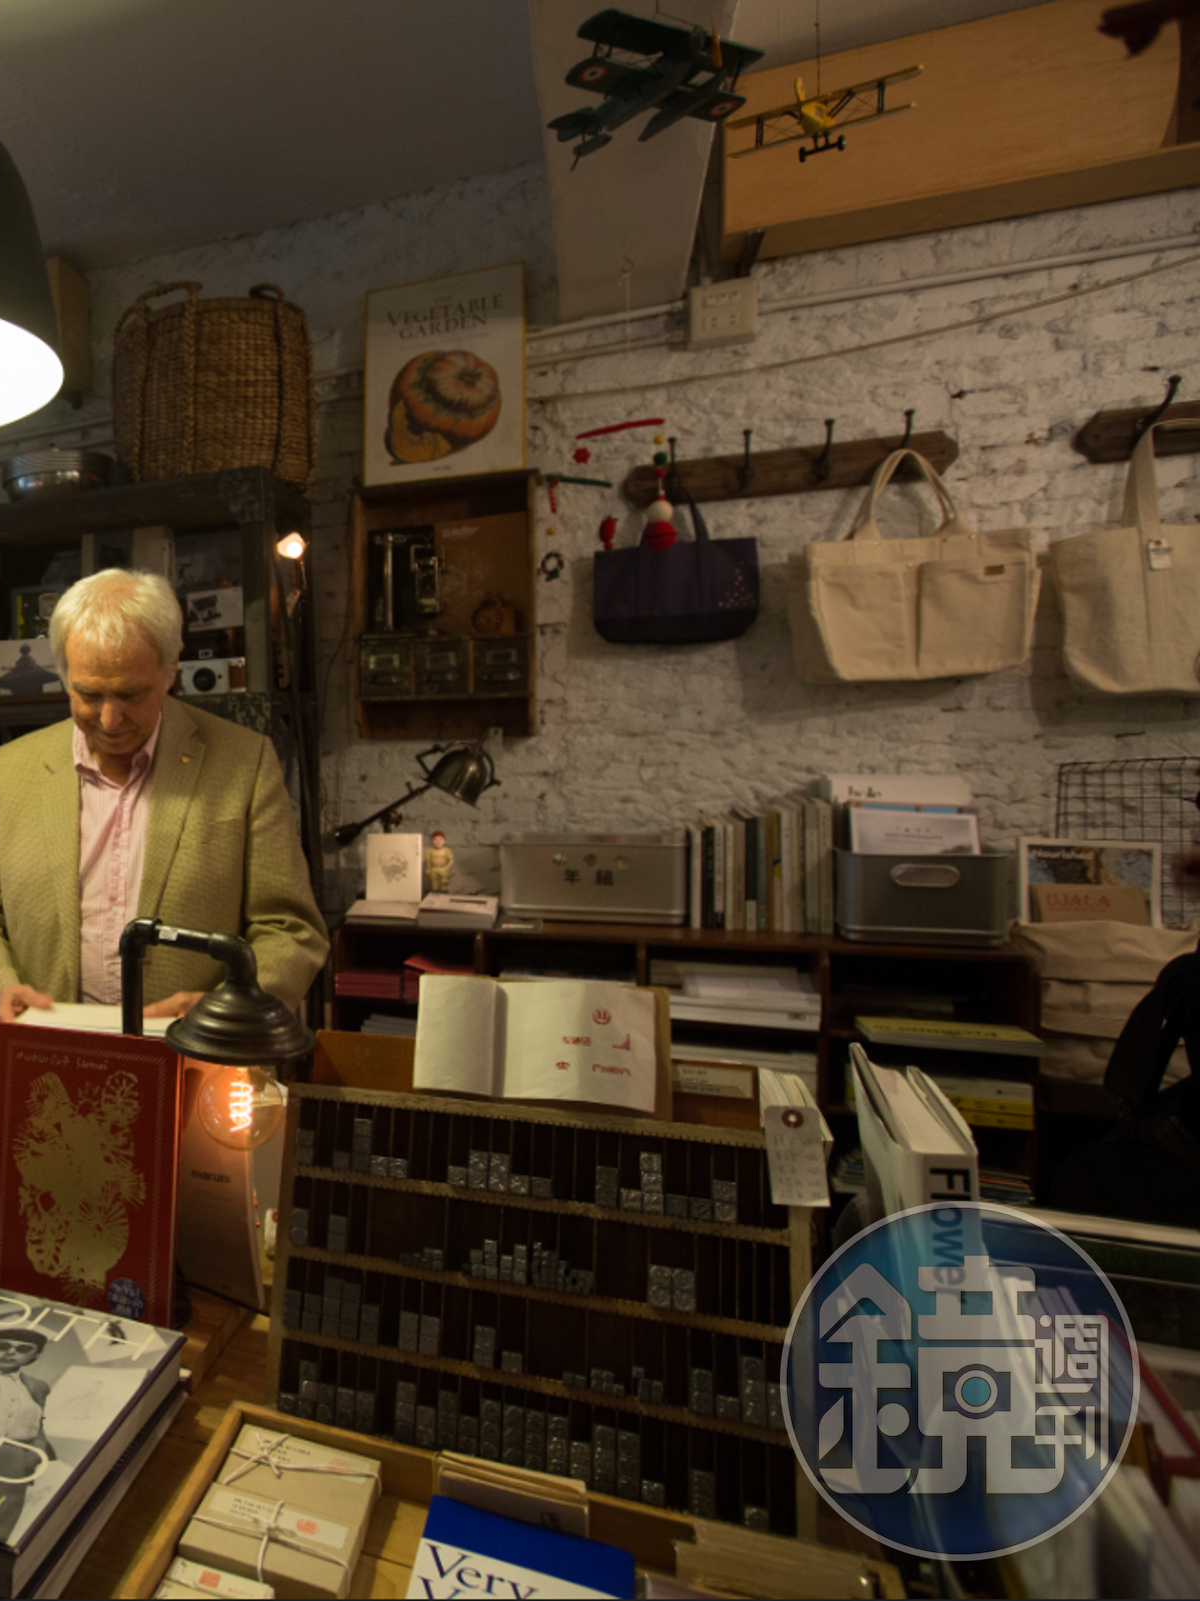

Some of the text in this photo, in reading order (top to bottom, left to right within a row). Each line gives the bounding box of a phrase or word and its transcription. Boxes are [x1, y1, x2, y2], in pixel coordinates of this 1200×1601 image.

[386, 293, 503, 327] VEGETABLE
[399, 311, 488, 340] GARDEN
[1046, 893, 1111, 908] UJALA
[425, 1543, 539, 1599] Very
